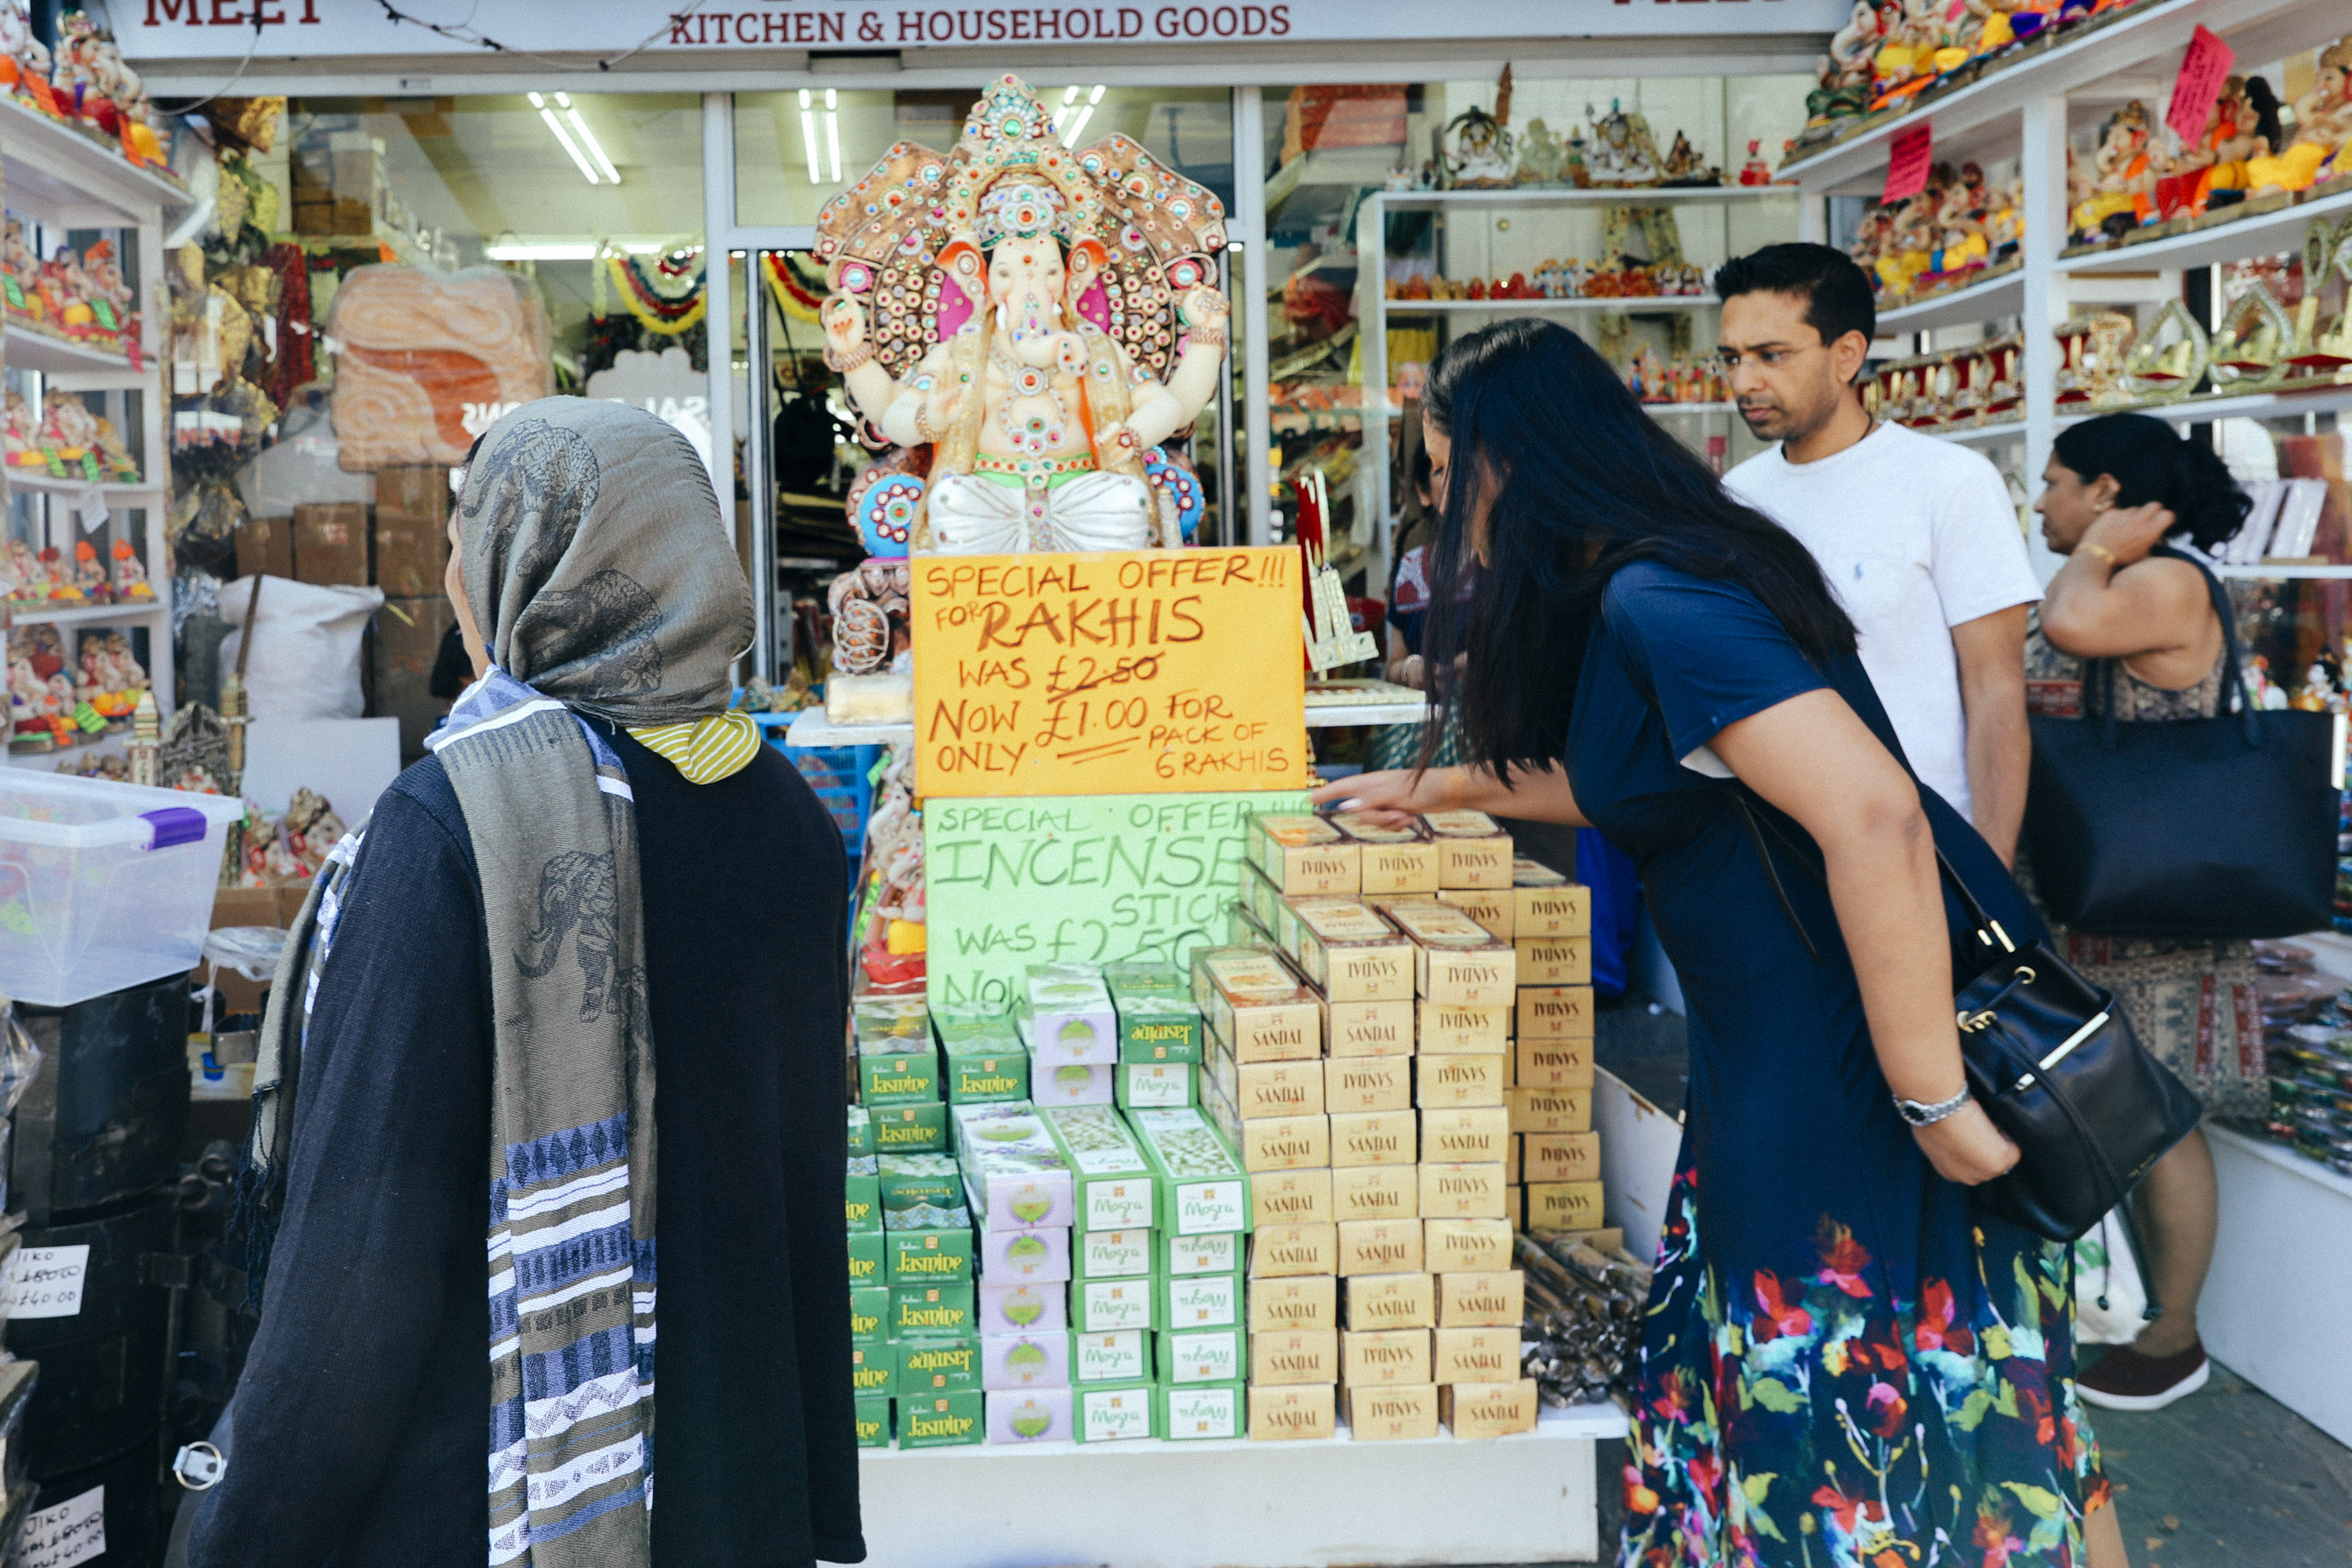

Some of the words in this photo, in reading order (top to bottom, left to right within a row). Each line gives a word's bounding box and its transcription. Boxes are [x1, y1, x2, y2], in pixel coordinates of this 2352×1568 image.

[670, 12, 845, 44] KITCHEN
[858, 10, 884, 42] &
[898, 8, 1143, 42] HOUSEHOLD
[1156, 5, 1291, 38] GOODS
[927, 563, 1090, 598] SPECIAL
[1118, 554, 1286, 590] OFFER!!!
[935, 600, 984, 631] FOR
[978, 594, 1204, 652] RAKHIS
[959, 657, 1031, 690] WAS
[1046, 652, 1165, 700] £2.50
[929, 699, 1021, 742] NOW
[1035, 697, 1149, 748] £1.00
[1167, 689, 1233, 721] FOR
[1149, 725, 1220, 749] PACK
[1233, 720, 1268, 741] OF
[938, 742, 1028, 776] ONLY
[1155, 753, 1175, 779] 6
[1182, 748, 1289, 774] RAKHIS
[938, 807, 1092, 832] SPECIAL
[934, 835, 1248, 891] INCENSE
[1302, 861, 1346, 875] SANDAL
[1379, 857, 1424, 872] SANDAL
[1451, 853, 1498, 868] SANDAL
[1461, 906, 1500, 920] SAND
[1532, 901, 1577, 915] SANDAL
[956, 923, 1036, 955] WAS
[1532, 948, 1577, 962] SANDAL
[1348, 961, 1398, 978] SANDAL
[1449, 967, 1498, 983] SANDAL
[1534, 1003, 1579, 1017] SANDAL
[1440, 1013, 1489, 1029] SANDAL
[1253, 1029, 1302, 1047] SANDAL
[1347, 1025, 1397, 1043] SANDAL
[1534, 1052, 1579, 1067] SANDAL
[1344, 1073, 1393, 1089] SANDAL
[1439, 1067, 1486, 1083] SANDAL
[870, 1074, 930, 1095] Jasmine
[958, 1074, 1018, 1094] Jasmine
[1255, 1087, 1305, 1103] SANDAL
[1531, 1098, 1576, 1112] SANDAL
[878, 1123, 937, 1144] Jasmine
[1261, 1141, 1310, 1158] SANDAL
[1348, 1136, 1397, 1152] SANDAL
[1441, 1134, 1489, 1150] SANDAL
[1541, 1147, 1585, 1162] SANDAL
[1439, 1178, 1489, 1194] SANDAL
[1265, 1195, 1313, 1213] SANDAL
[1350, 1191, 1399, 1207] SANDAL
[1546, 1195, 1590, 1210] SANDAL
[1446, 1235, 1496, 1250] SANDAL
[1270, 1247, 1317, 1264] SANDAL
[1357, 1244, 1405, 1261] SANDAL
[896, 1250, 963, 1274] Jasmine
[1268, 1303, 1316, 1319] SANDAL
[1367, 1300, 1416, 1316] SANDAL
[1458, 1298, 1506, 1312] SANDAL
[898, 1304, 965, 1327] Jasmine
[1272, 1356, 1319, 1370] SANDAL
[1363, 1347, 1414, 1363] SANDAL
[1454, 1354, 1502, 1370] SANDAL
[1370, 1402, 1421, 1417] SANDAL
[1472, 1405, 1519, 1421] SANDAL
[907, 1414, 974, 1438] Jasmine
[1267, 1411, 1316, 1427] SANDAL
